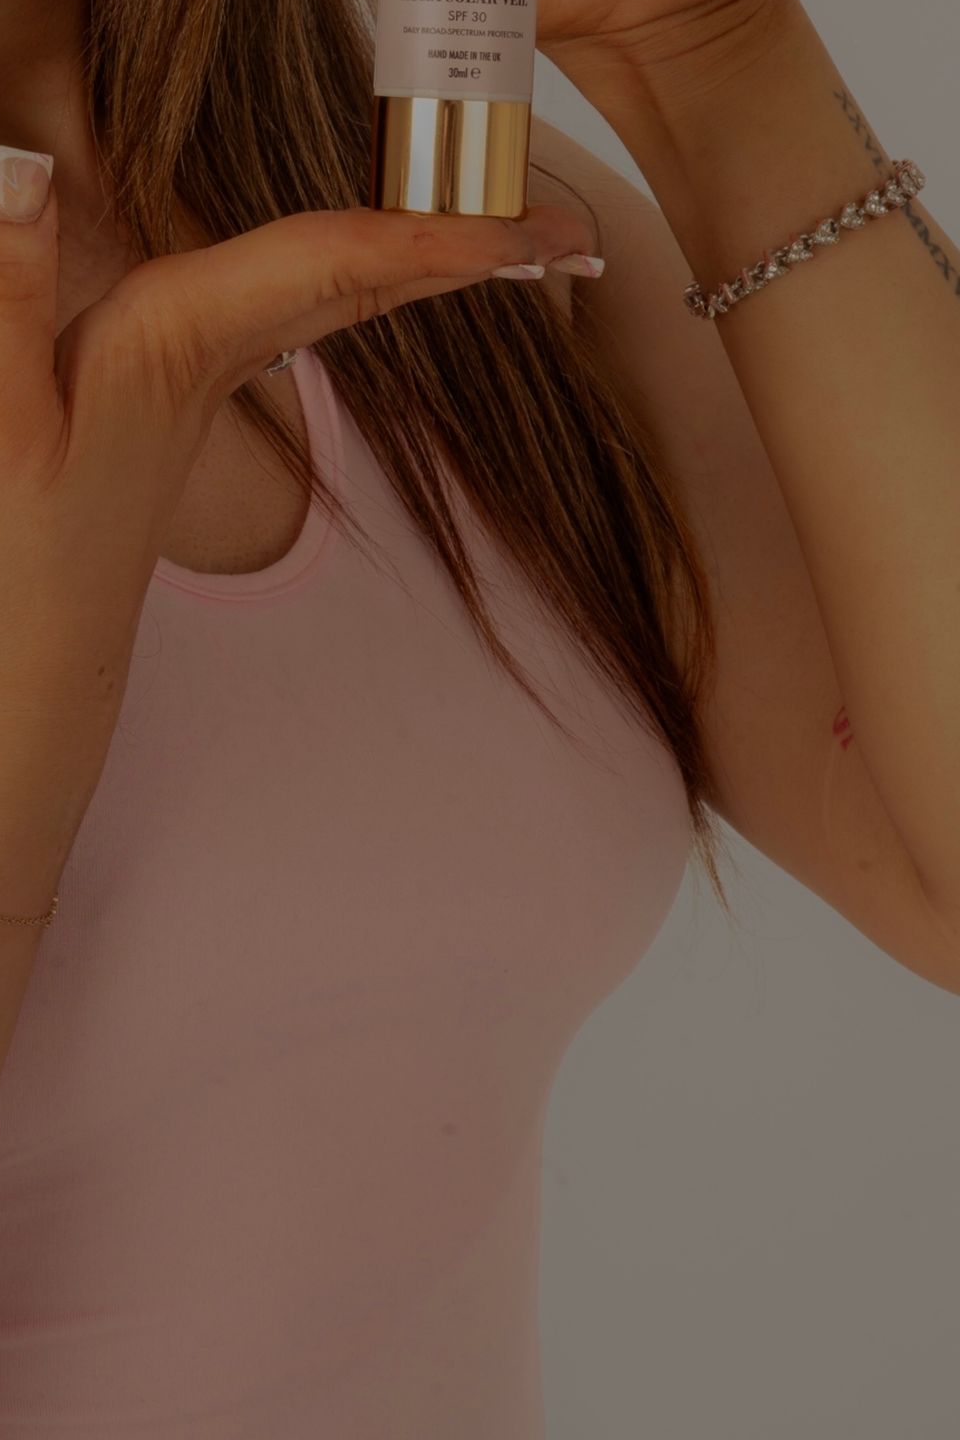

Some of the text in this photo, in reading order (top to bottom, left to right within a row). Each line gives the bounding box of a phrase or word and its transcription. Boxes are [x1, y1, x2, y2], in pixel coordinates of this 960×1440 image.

[448, 10, 487, 23] SPF 30
[403, 26, 420, 34] DAILY
[488, 30, 524, 39] PROTECTION
[428, 49, 501, 62] HAND MADE IN THE UK
[448, 67, 468, 78] 30ml
